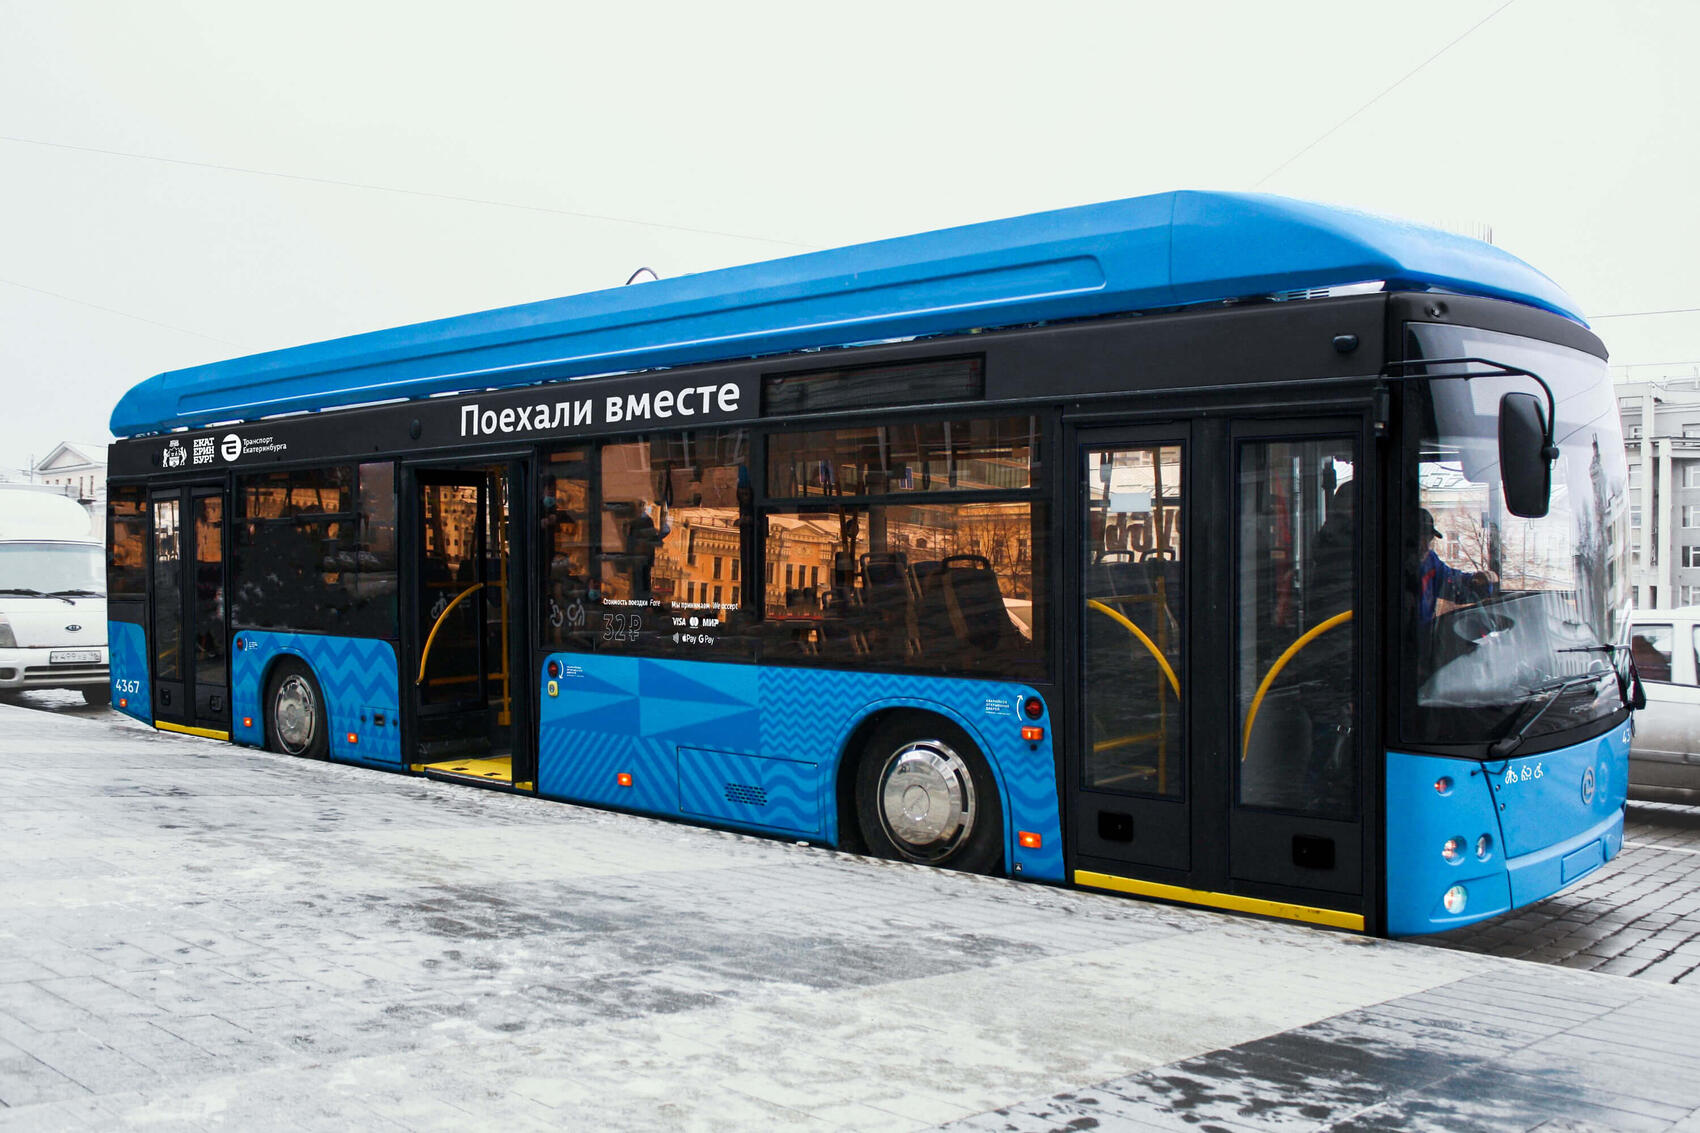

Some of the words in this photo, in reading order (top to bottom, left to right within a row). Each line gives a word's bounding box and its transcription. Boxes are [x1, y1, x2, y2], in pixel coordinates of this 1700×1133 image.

[460, 400, 593, 437] Поехали
[605, 382, 740, 423] вместе
[193, 437, 215, 447] ЕКАТ
[243, 437, 273, 446] Транспорт
[193, 446, 215, 456] ЕРИН
[243, 443, 287, 454] Екатеринбурга
[193, 454, 215, 464] БУРГ
[672, 617, 686, 626] VISA
[702, 618, 719, 627] МИР
[115, 679, 140, 694] 4367
